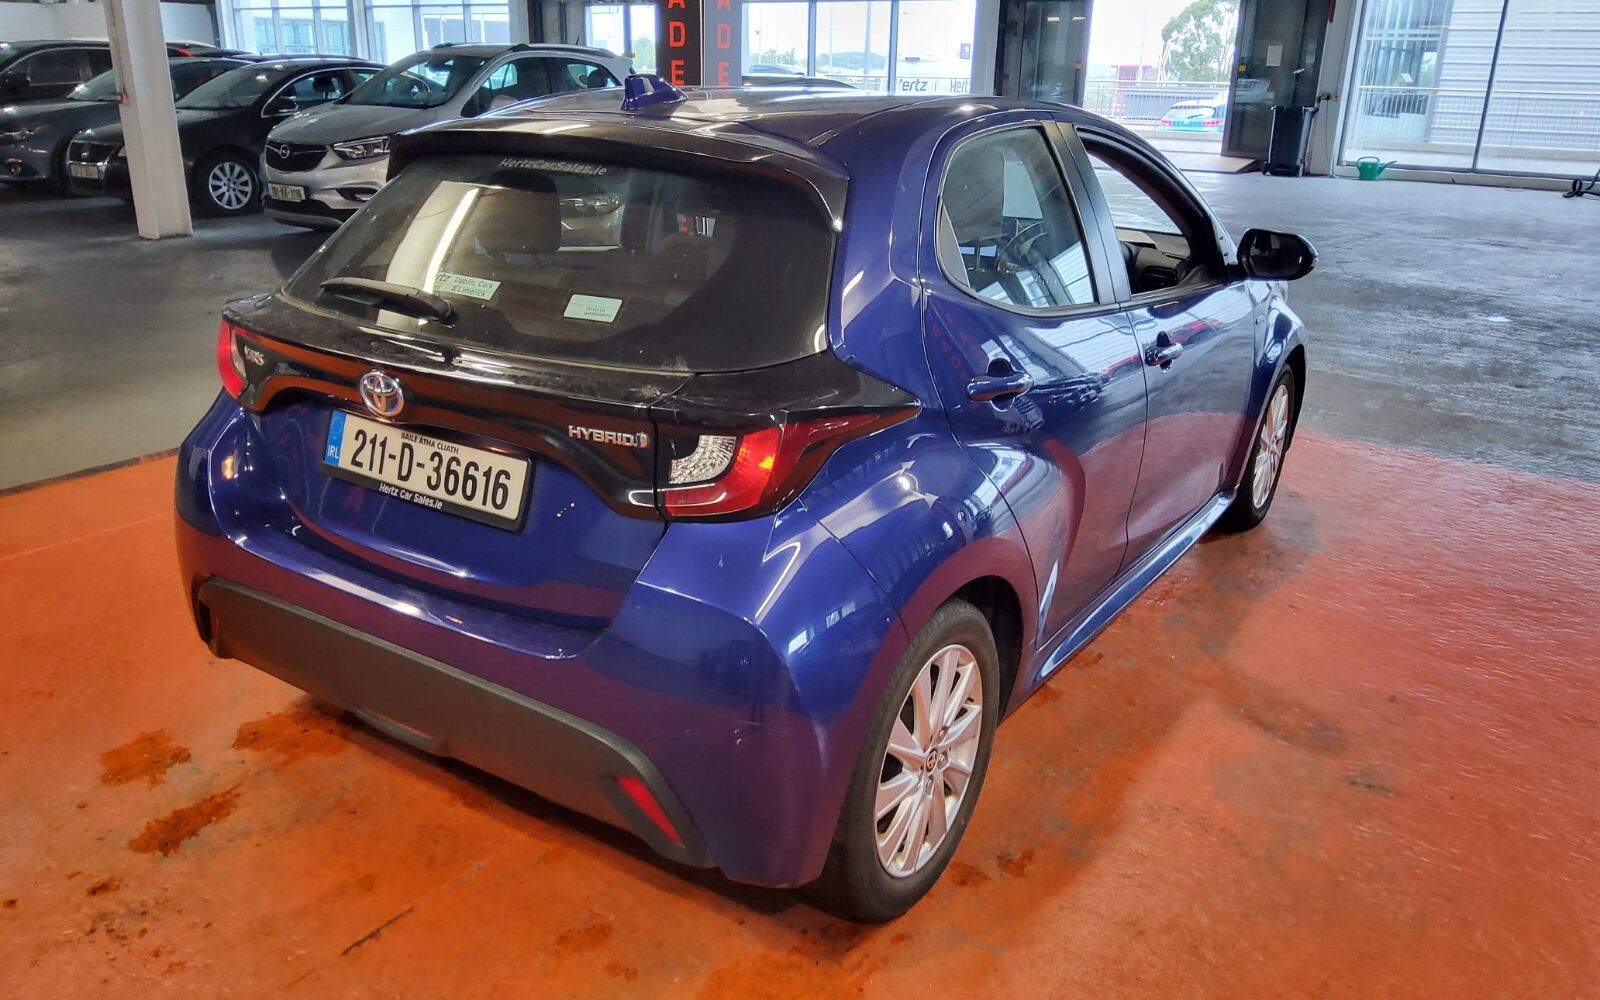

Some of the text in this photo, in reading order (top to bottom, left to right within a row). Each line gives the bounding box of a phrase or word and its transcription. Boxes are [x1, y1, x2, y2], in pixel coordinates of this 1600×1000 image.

[950, 77, 970, 93] Hert
[499, 158, 608, 176] HertzCarSales.ie
[477, 281, 493, 289] Cork
[400, 432, 418, 443] BAILE
[436, 442, 460, 455] CLIATH
[568, 425, 635, 447] HYBRID
[327, 444, 339, 460] IRL
[350, 429, 511, 510] 211-D-36616
[379, 482, 443, 510] Hertz Car Sales.ie
